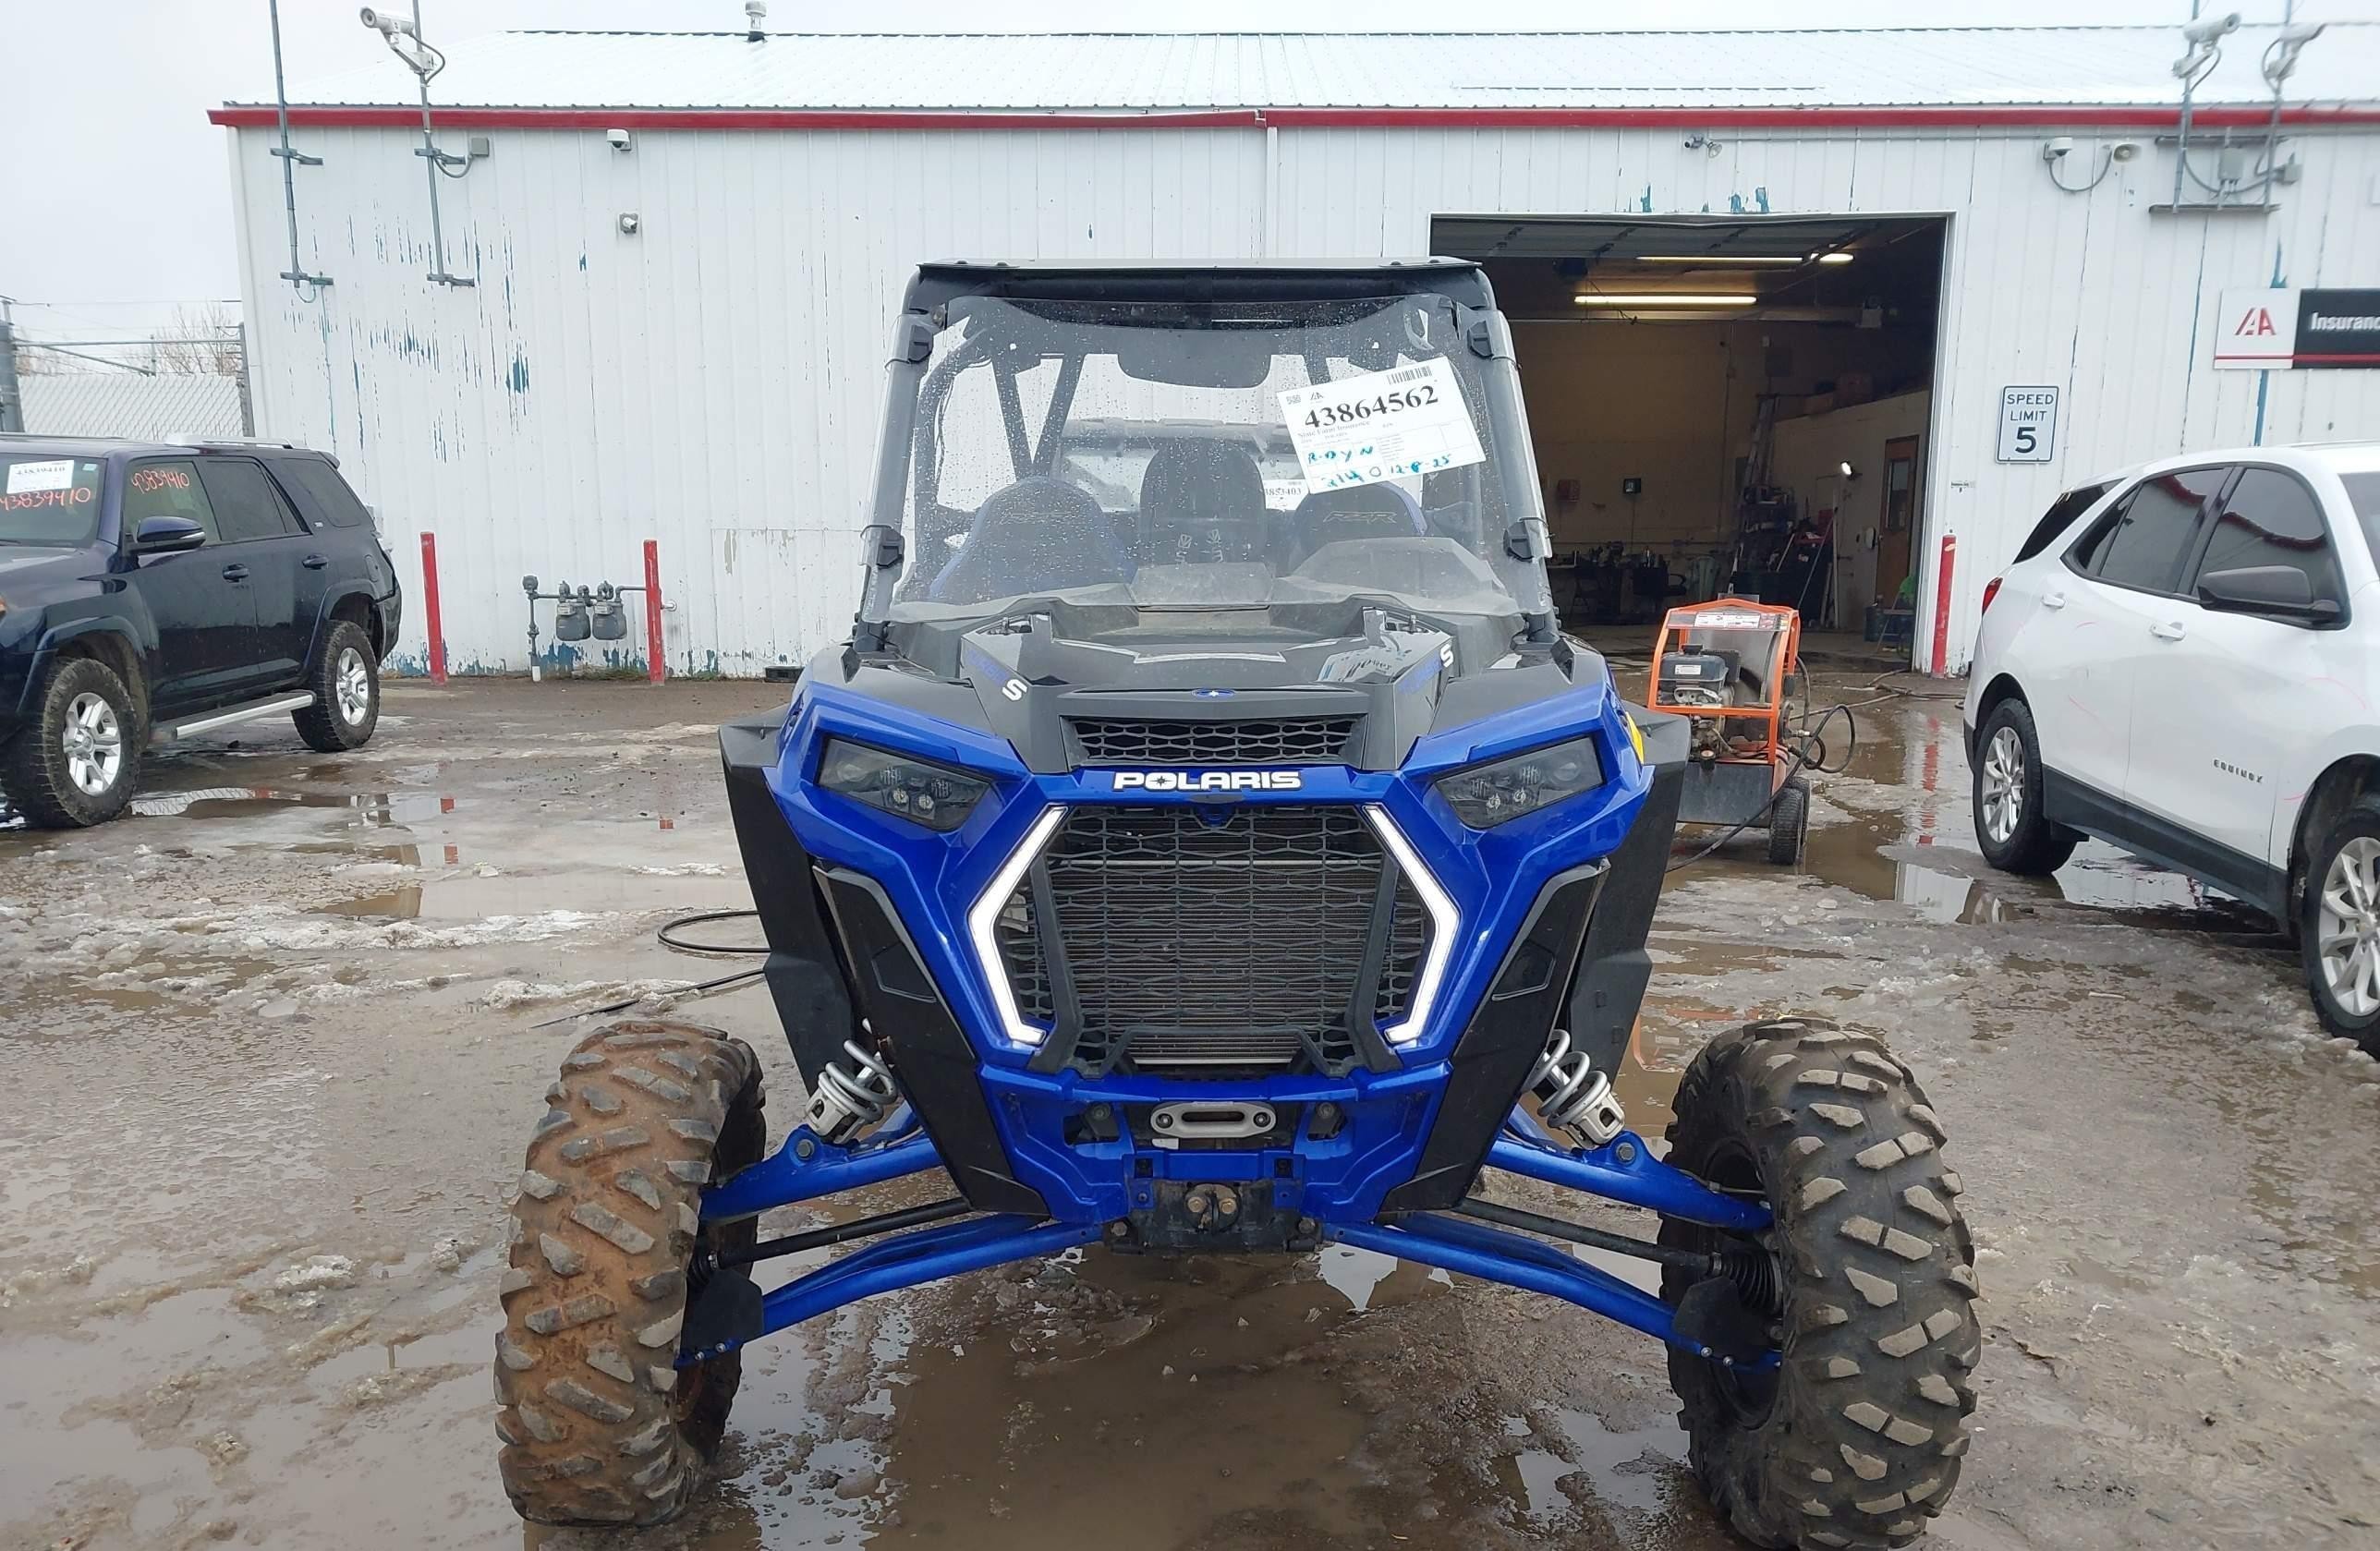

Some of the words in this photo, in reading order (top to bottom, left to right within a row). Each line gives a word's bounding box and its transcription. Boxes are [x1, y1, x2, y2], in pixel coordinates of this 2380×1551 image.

[1305, 384, 1439, 428] 43864562
[2006, 394, 2054, 405] SPEED
[2010, 410, 2047, 421] LIMIT
[1317, 427, 1336, 435] Farm
[1337, 420, 1370, 430] Insurance
[2015, 426, 2037, 454] 5
[0, 488, 91, 511] 43839410
[1112, 771, 1302, 792] POLARIS
[2214, 759, 2263, 783] EQUINOX
